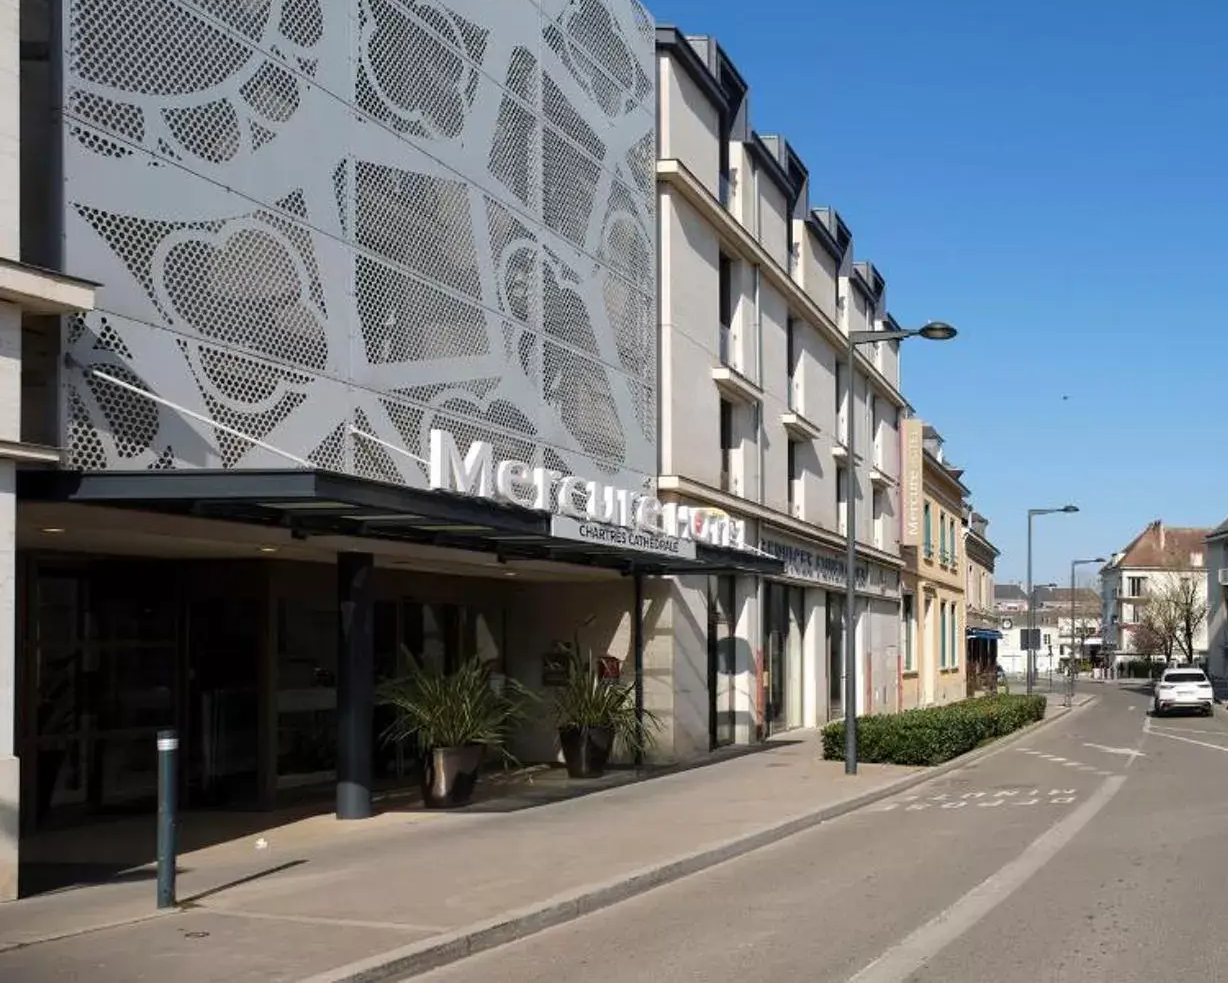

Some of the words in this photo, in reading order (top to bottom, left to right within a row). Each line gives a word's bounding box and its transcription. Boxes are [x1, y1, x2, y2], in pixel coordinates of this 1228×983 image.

[429, 428, 664, 535] Mercure
[906, 469, 920, 536] Mercure
[578, 524, 627, 545] CHARTRES
